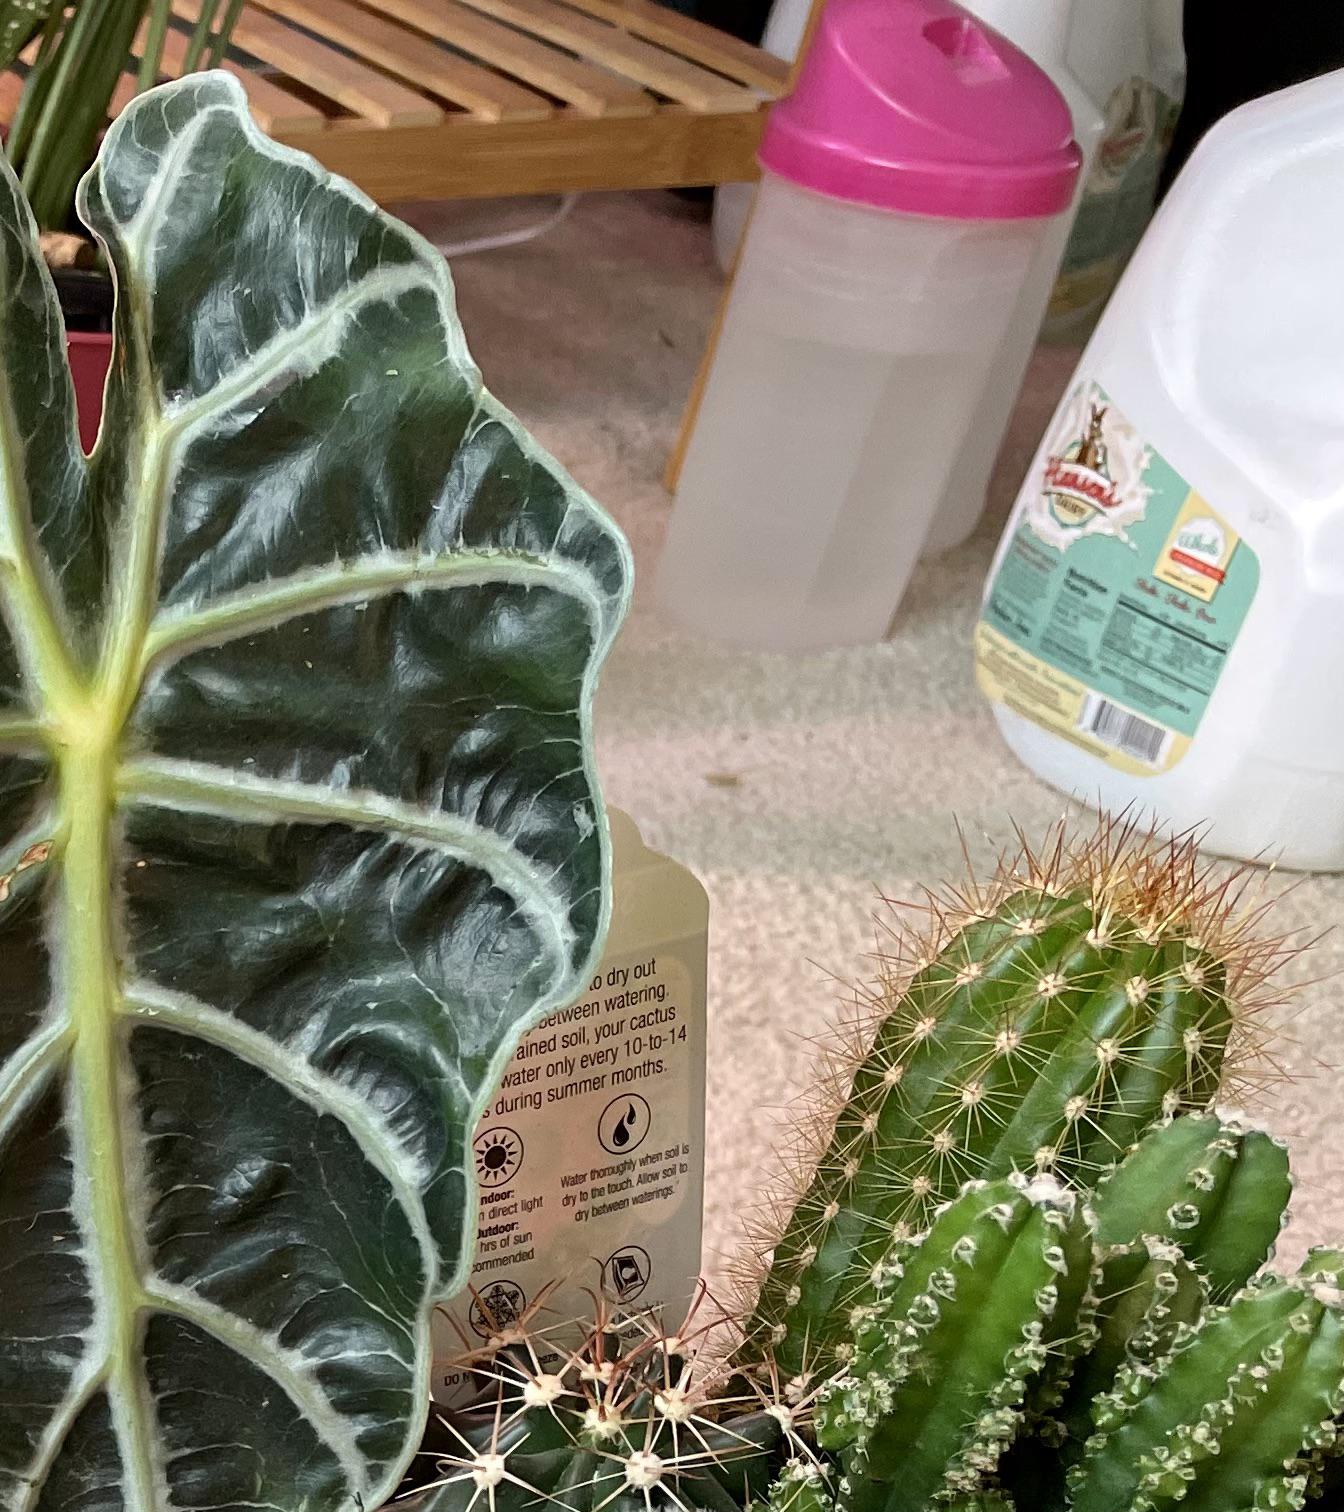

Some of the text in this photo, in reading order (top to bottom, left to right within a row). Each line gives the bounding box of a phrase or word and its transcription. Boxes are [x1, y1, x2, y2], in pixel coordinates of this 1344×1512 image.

[606, 966, 629, 987] dry
[633, 957, 656, 979] out
[604, 983, 670, 1013] watering.
[514, 1005, 677, 1061] ained soil, your cactus
[500, 1023, 688, 1089] water only every 10-to-14
[495, 1058, 669, 1116] during summer months.
[560, 1142, 690, 1189] Water thoroughly when soil is
[480, 1189, 515, 1206] ndoor:
[561, 1161, 689, 1208] dry to the touch. Allow soil to
[488, 1201, 519, 1220] direct
[520, 1195, 544, 1214] light
[574, 1208, 590, 1223] dry
[591, 1197, 630, 1218] between
[480, 1231, 534, 1254] hrs of sun
[444, 1373, 460, 1387] DO
